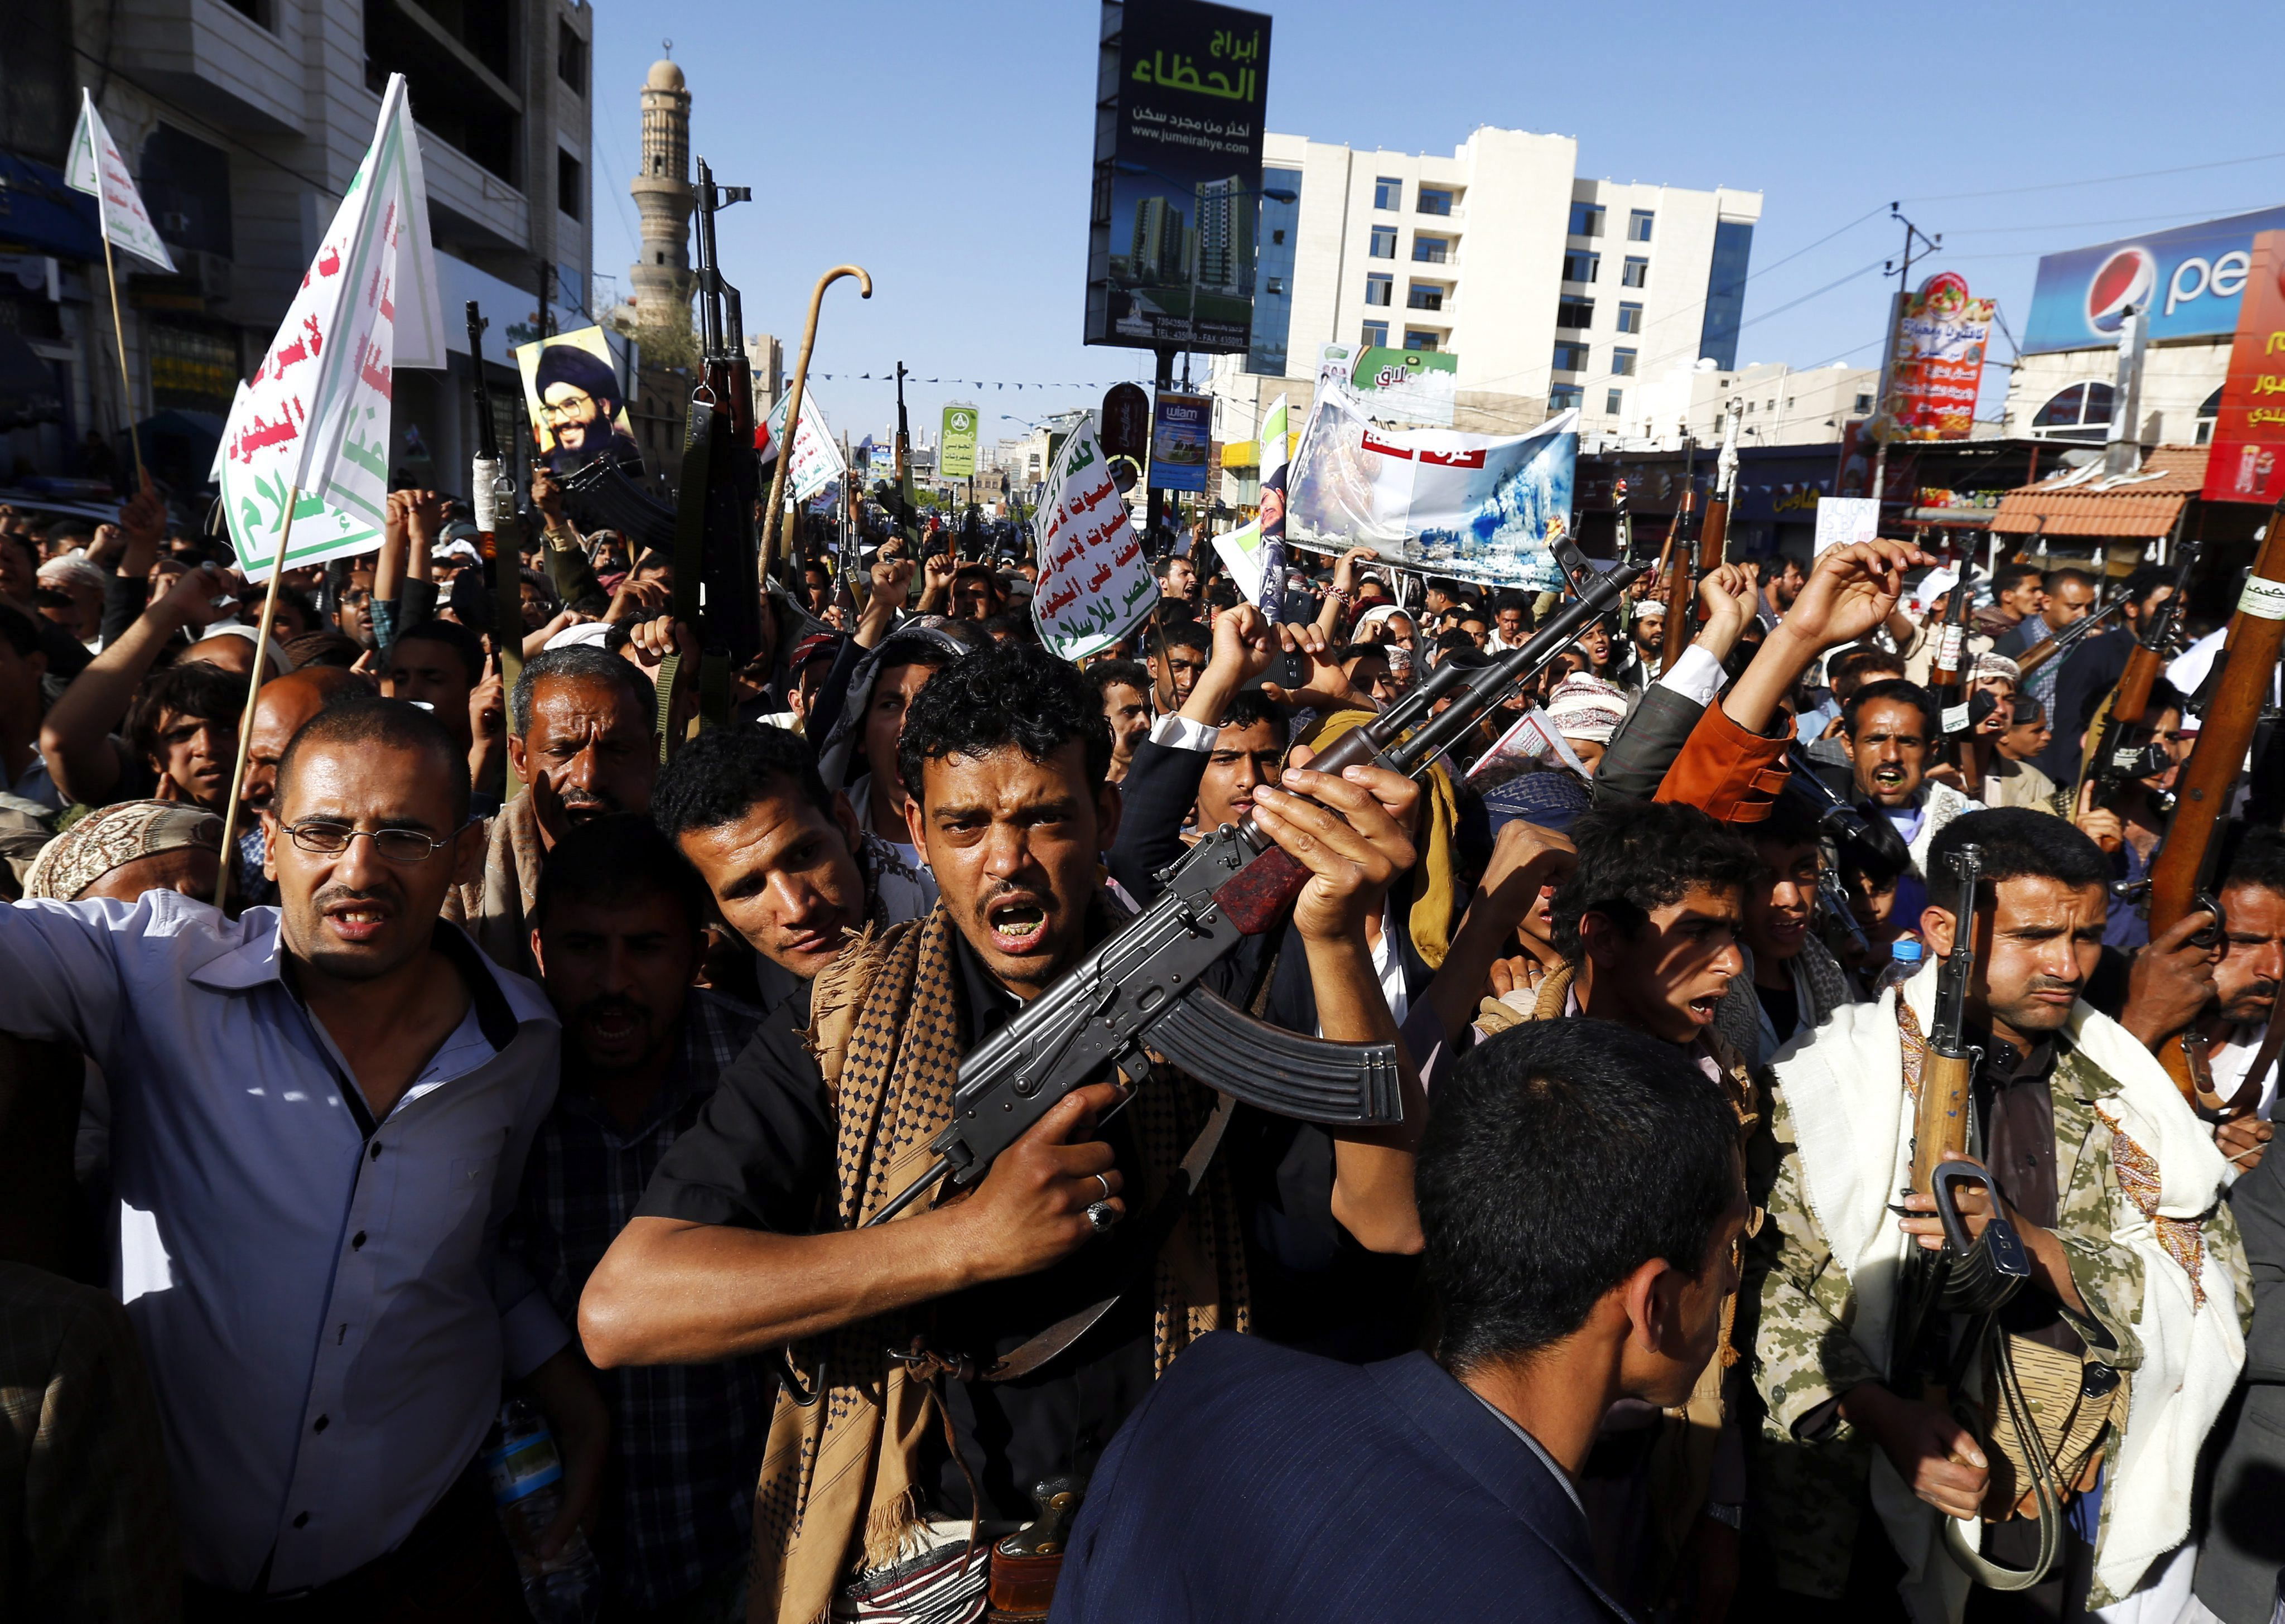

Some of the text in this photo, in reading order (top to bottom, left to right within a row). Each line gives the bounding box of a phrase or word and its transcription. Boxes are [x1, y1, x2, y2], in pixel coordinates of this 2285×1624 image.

[1209, 29, 1259, 64] أبراج
[1131, 49, 1255, 102] الحظاء
[1132, 105, 1166, 122] سكن
[1170, 114, 1201, 130] مجرد
[1203, 119, 1222, 133] من
[1131, 125, 1249, 155] www.jumeirahye.com
[1066, 437, 1096, 478] لله
[1069, 470, 1115, 515] لموت
[1820, 497, 1878, 515] VICTORY
[1086, 502, 1127, 547] لموت
[1819, 531, 1854, 545] FAITH
[1820, 513, 1858, 531] IS BY
[1040, 533, 1141, 621] للعنة على اليهود
[1054, 561, 1153, 657] لنصر للإسلام
